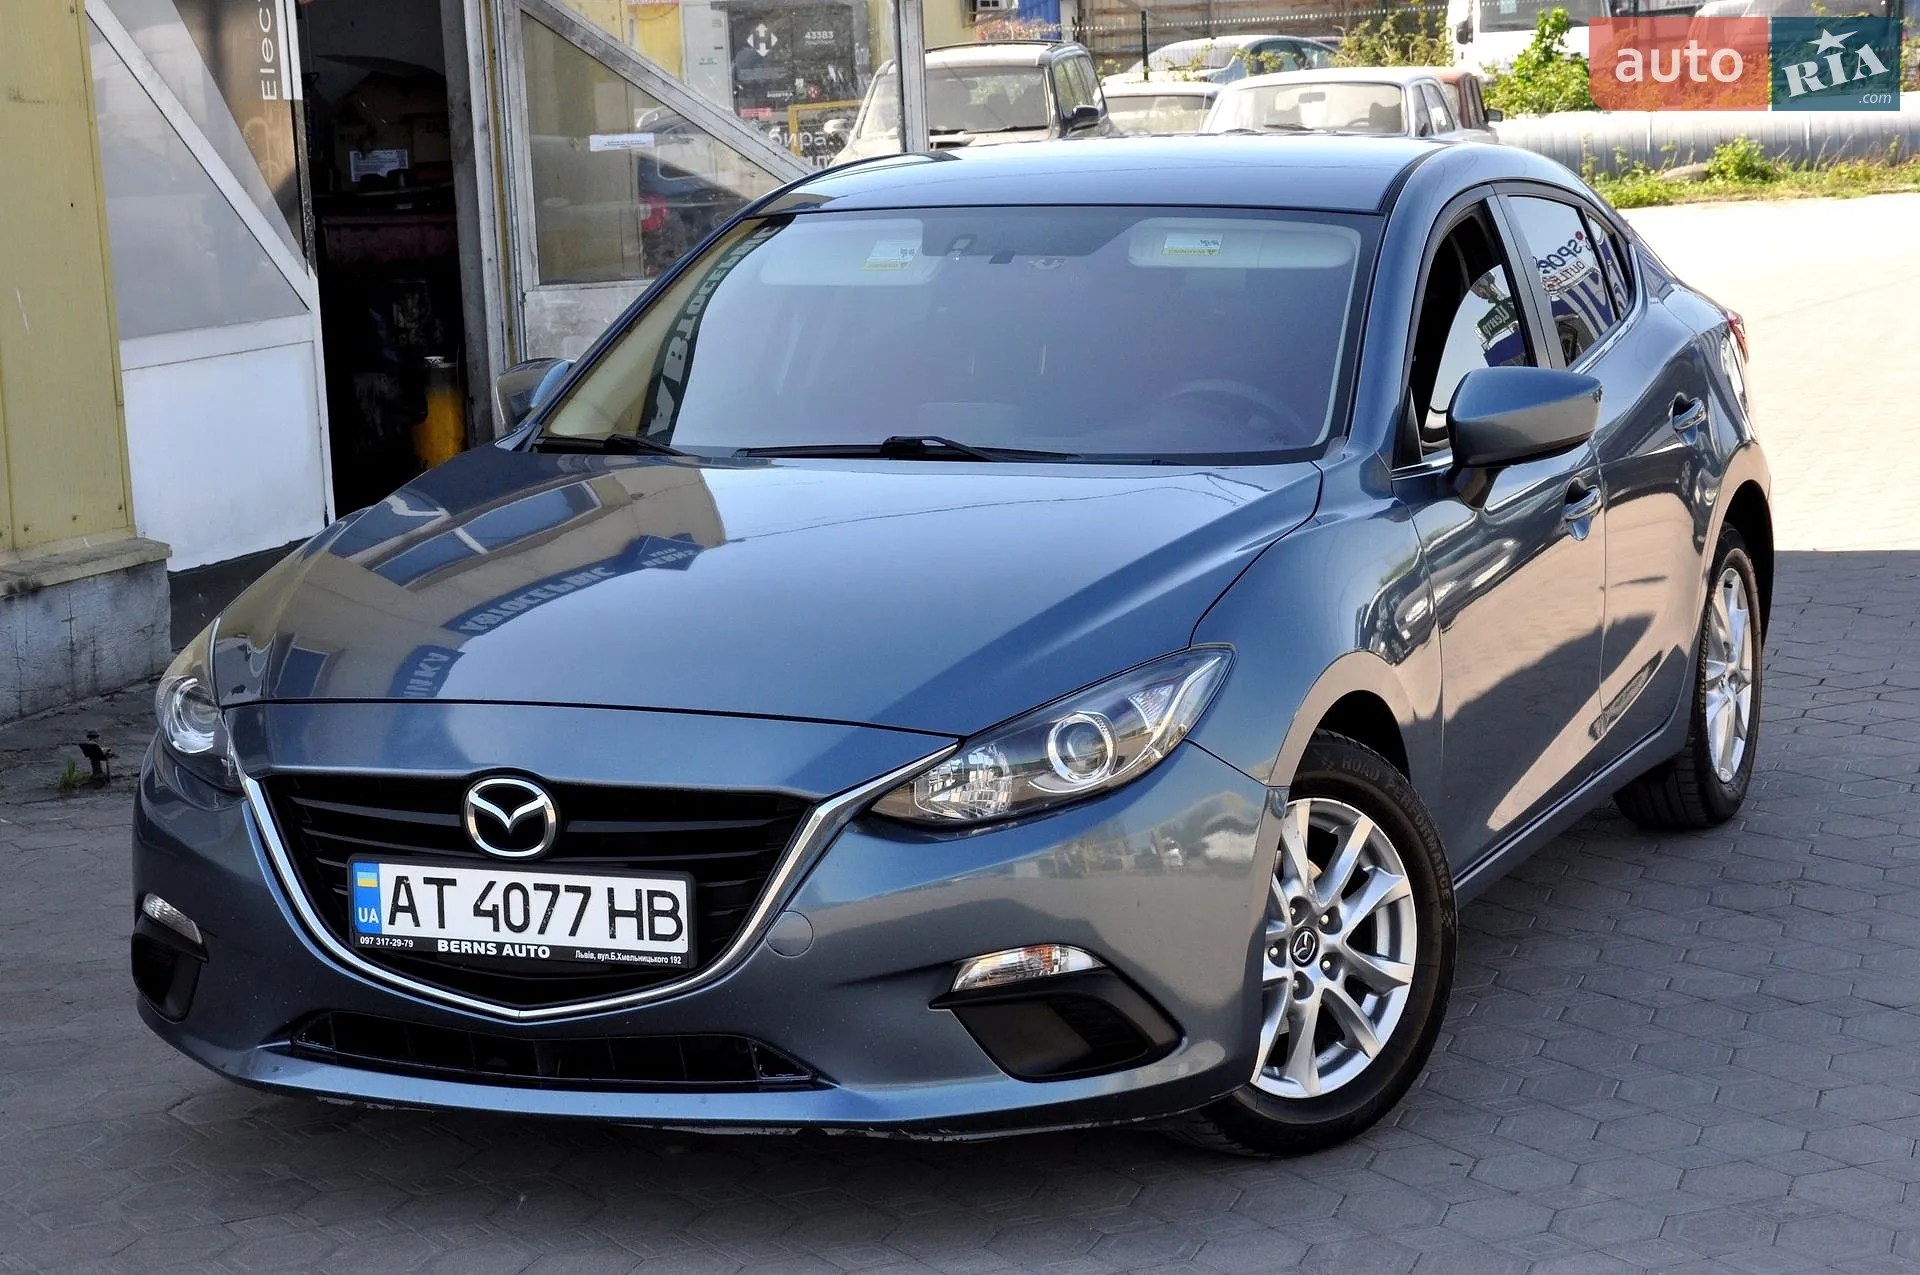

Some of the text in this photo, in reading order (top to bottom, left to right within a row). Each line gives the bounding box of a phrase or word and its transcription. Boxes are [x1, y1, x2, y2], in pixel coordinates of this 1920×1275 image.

[258, 0, 278, 100] Elec
[1341, 756, 1381, 781] ROAD
[358, 907, 379, 924] UA
[388, 875, 684, 942] AT 4077 HB
[359, 936, 414, 948] 097 317-29-79
[437, 939, 551, 958] BERNS AUTO
[669, 955, 682, 965] 192
